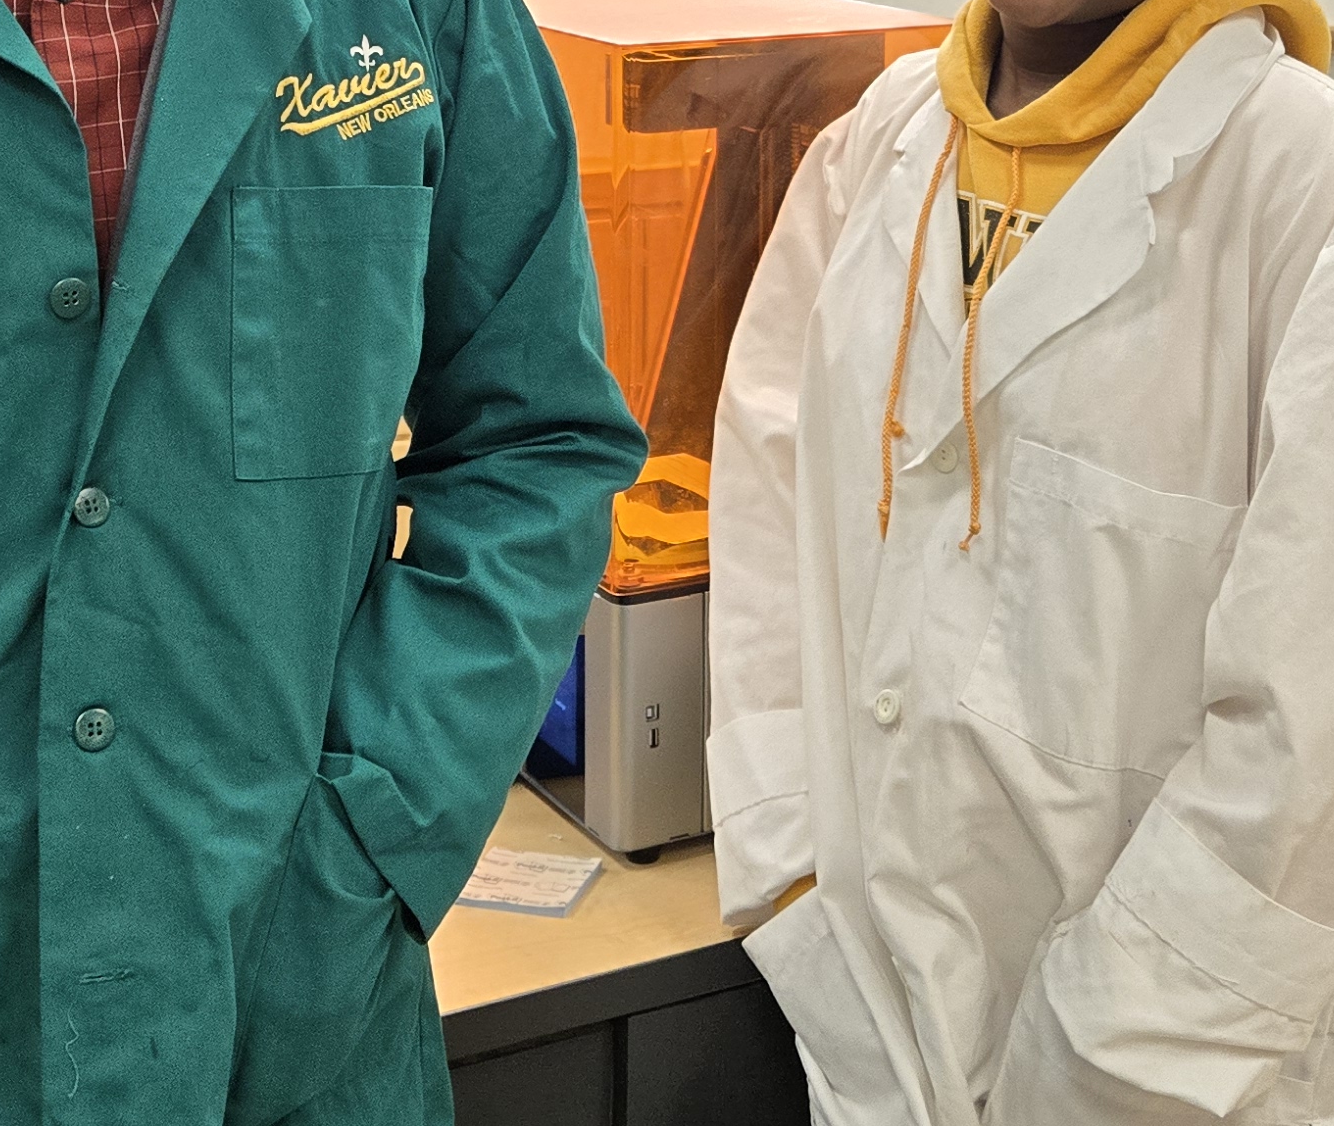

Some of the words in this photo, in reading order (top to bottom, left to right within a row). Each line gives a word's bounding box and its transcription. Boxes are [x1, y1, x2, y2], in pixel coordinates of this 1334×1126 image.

[275, 57, 425, 123] Xavier
[336, 112, 372, 141] NEW
[373, 88, 435, 123] ORLEANS
